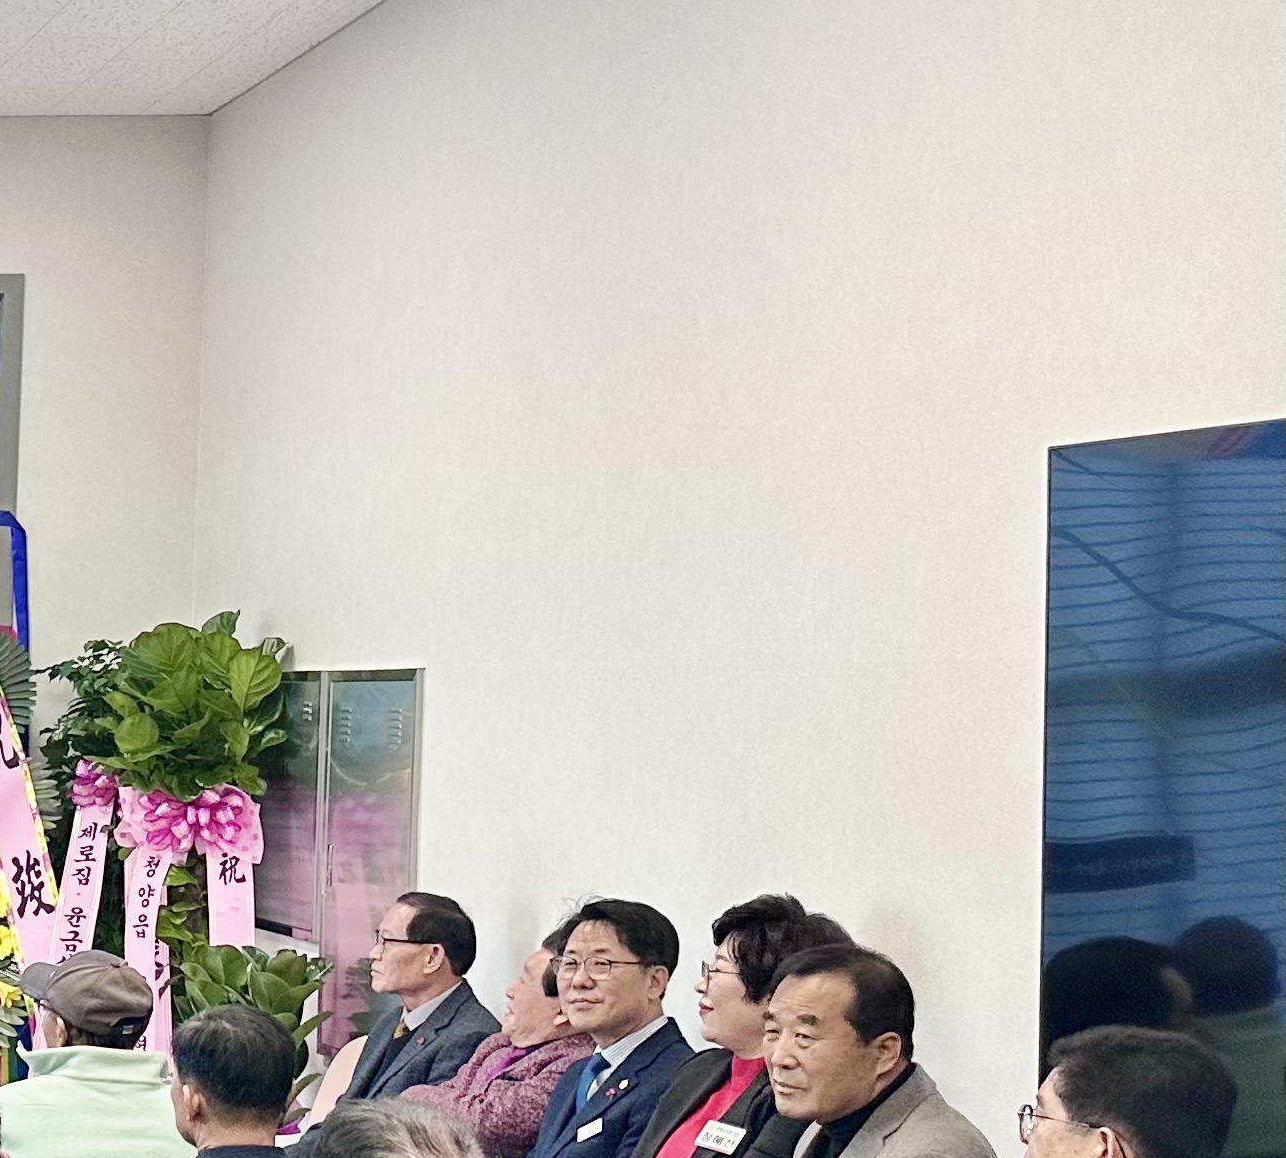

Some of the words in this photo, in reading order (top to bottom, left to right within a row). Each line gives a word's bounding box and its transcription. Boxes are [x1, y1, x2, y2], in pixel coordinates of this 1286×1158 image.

[71, 821, 97, 886] 제로짐
[219, 853, 247, 886] 祝
[133, 855, 160, 939] 청양읍
[56, 906, 88, 964] 윤금
